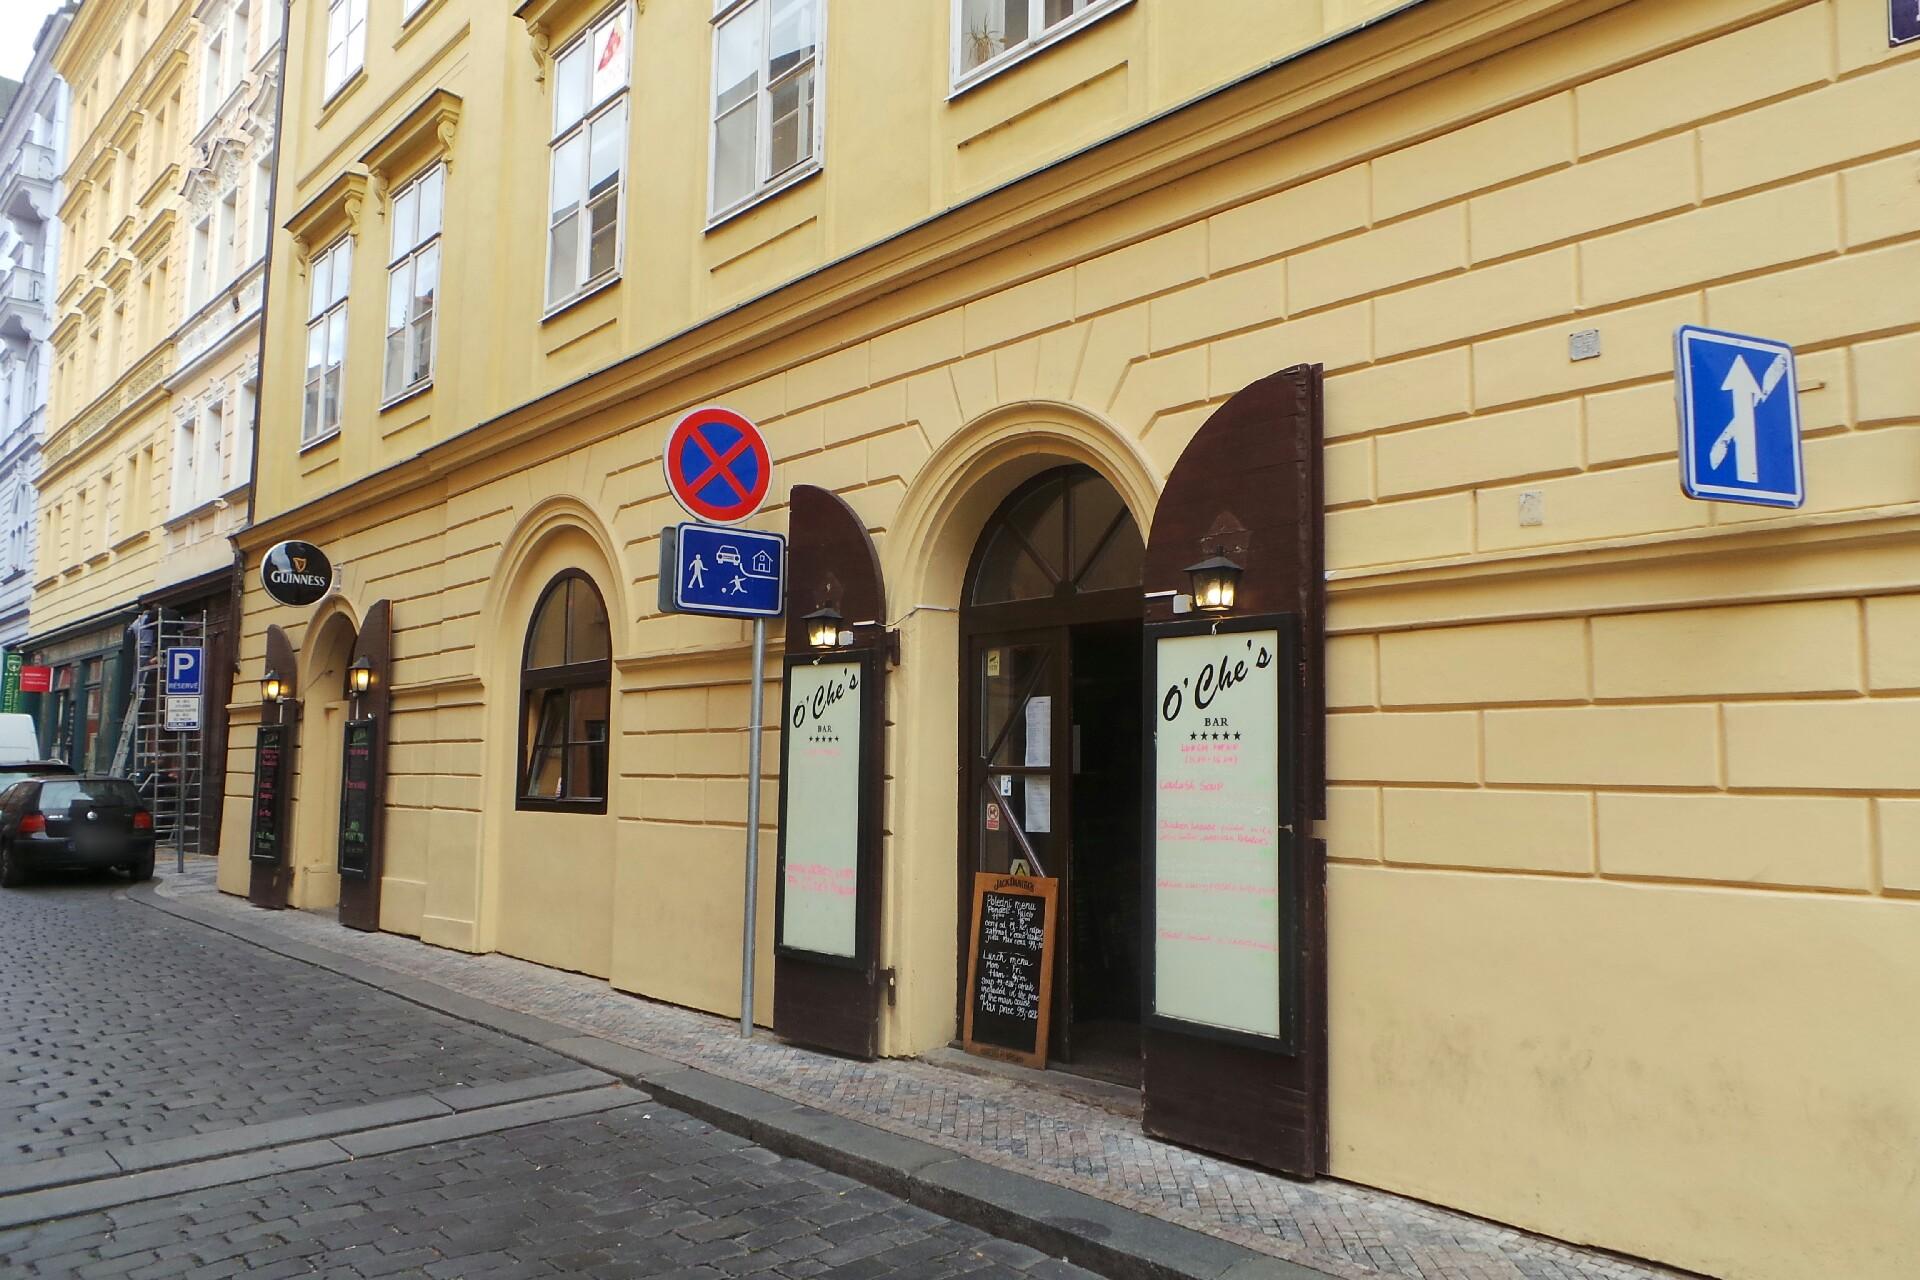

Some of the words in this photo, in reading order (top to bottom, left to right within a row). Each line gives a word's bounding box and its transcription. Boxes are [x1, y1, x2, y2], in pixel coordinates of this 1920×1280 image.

[271, 570, 325, 587] GUINNESS
[173, 653, 194, 680] P
[1162, 639, 1272, 721] O'Che's
[793, 667, 859, 729] O'Che's
[817, 725, 833, 733] BAR
[1204, 717, 1229, 727] BAR
[1014, 901, 1036, 911] menu
[983, 949, 1007, 963] Lunch
[1009, 956, 1033, 967] menu
